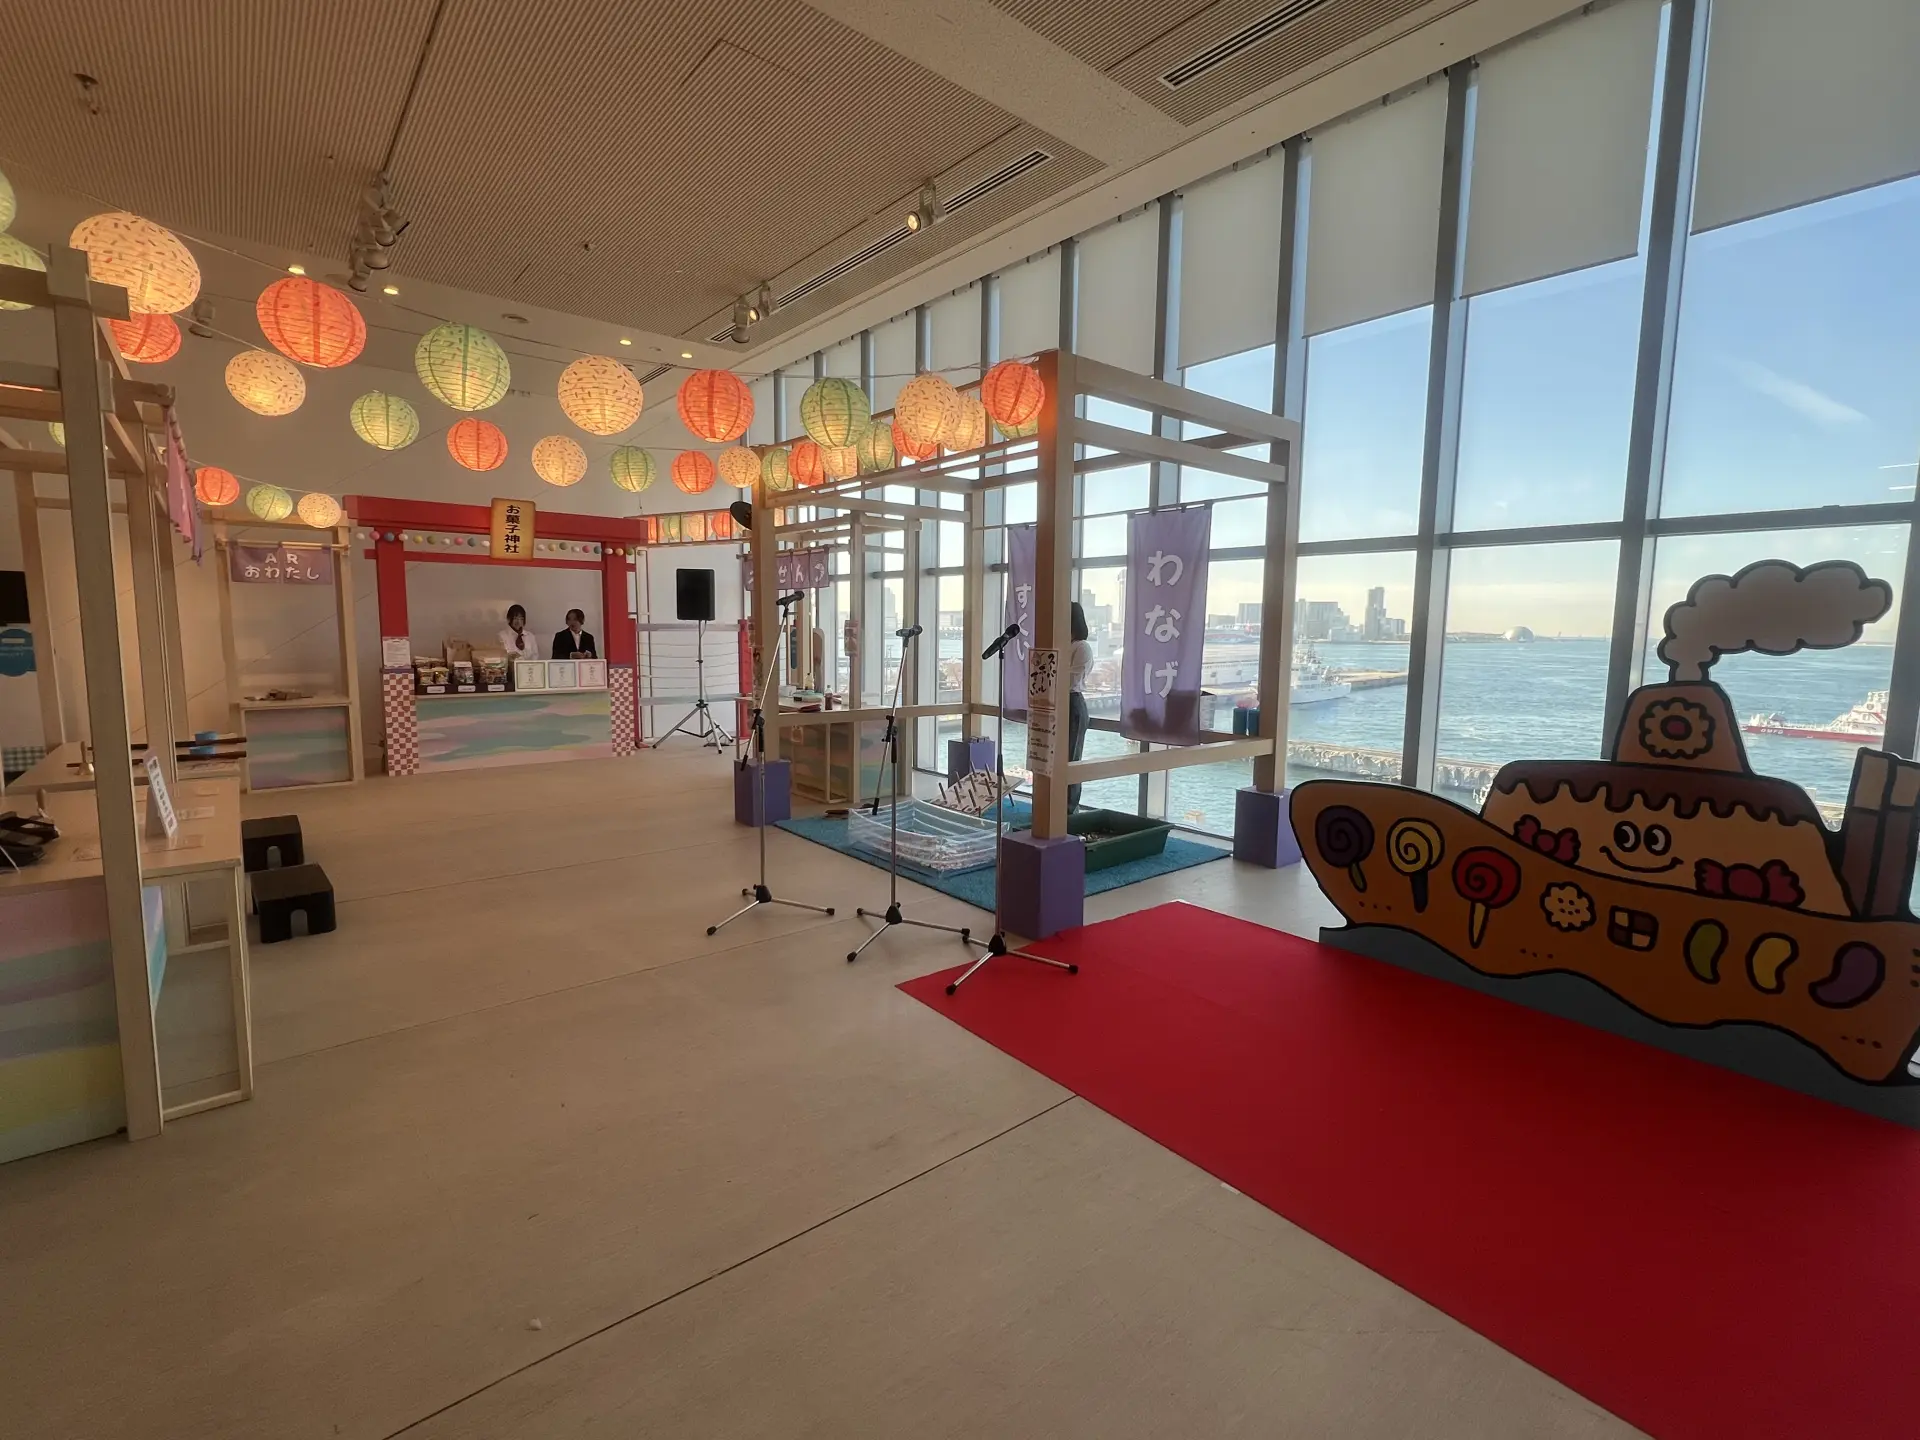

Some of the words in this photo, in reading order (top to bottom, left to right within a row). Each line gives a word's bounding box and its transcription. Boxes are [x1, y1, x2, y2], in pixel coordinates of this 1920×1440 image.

[504, 504, 521, 554] お菓子神社
[244, 564, 320, 580] おわたし
[264, 552, 299, 565] AR
[1014, 583, 1033, 661] すくい
[1143, 550, 1184, 699] わなげ
